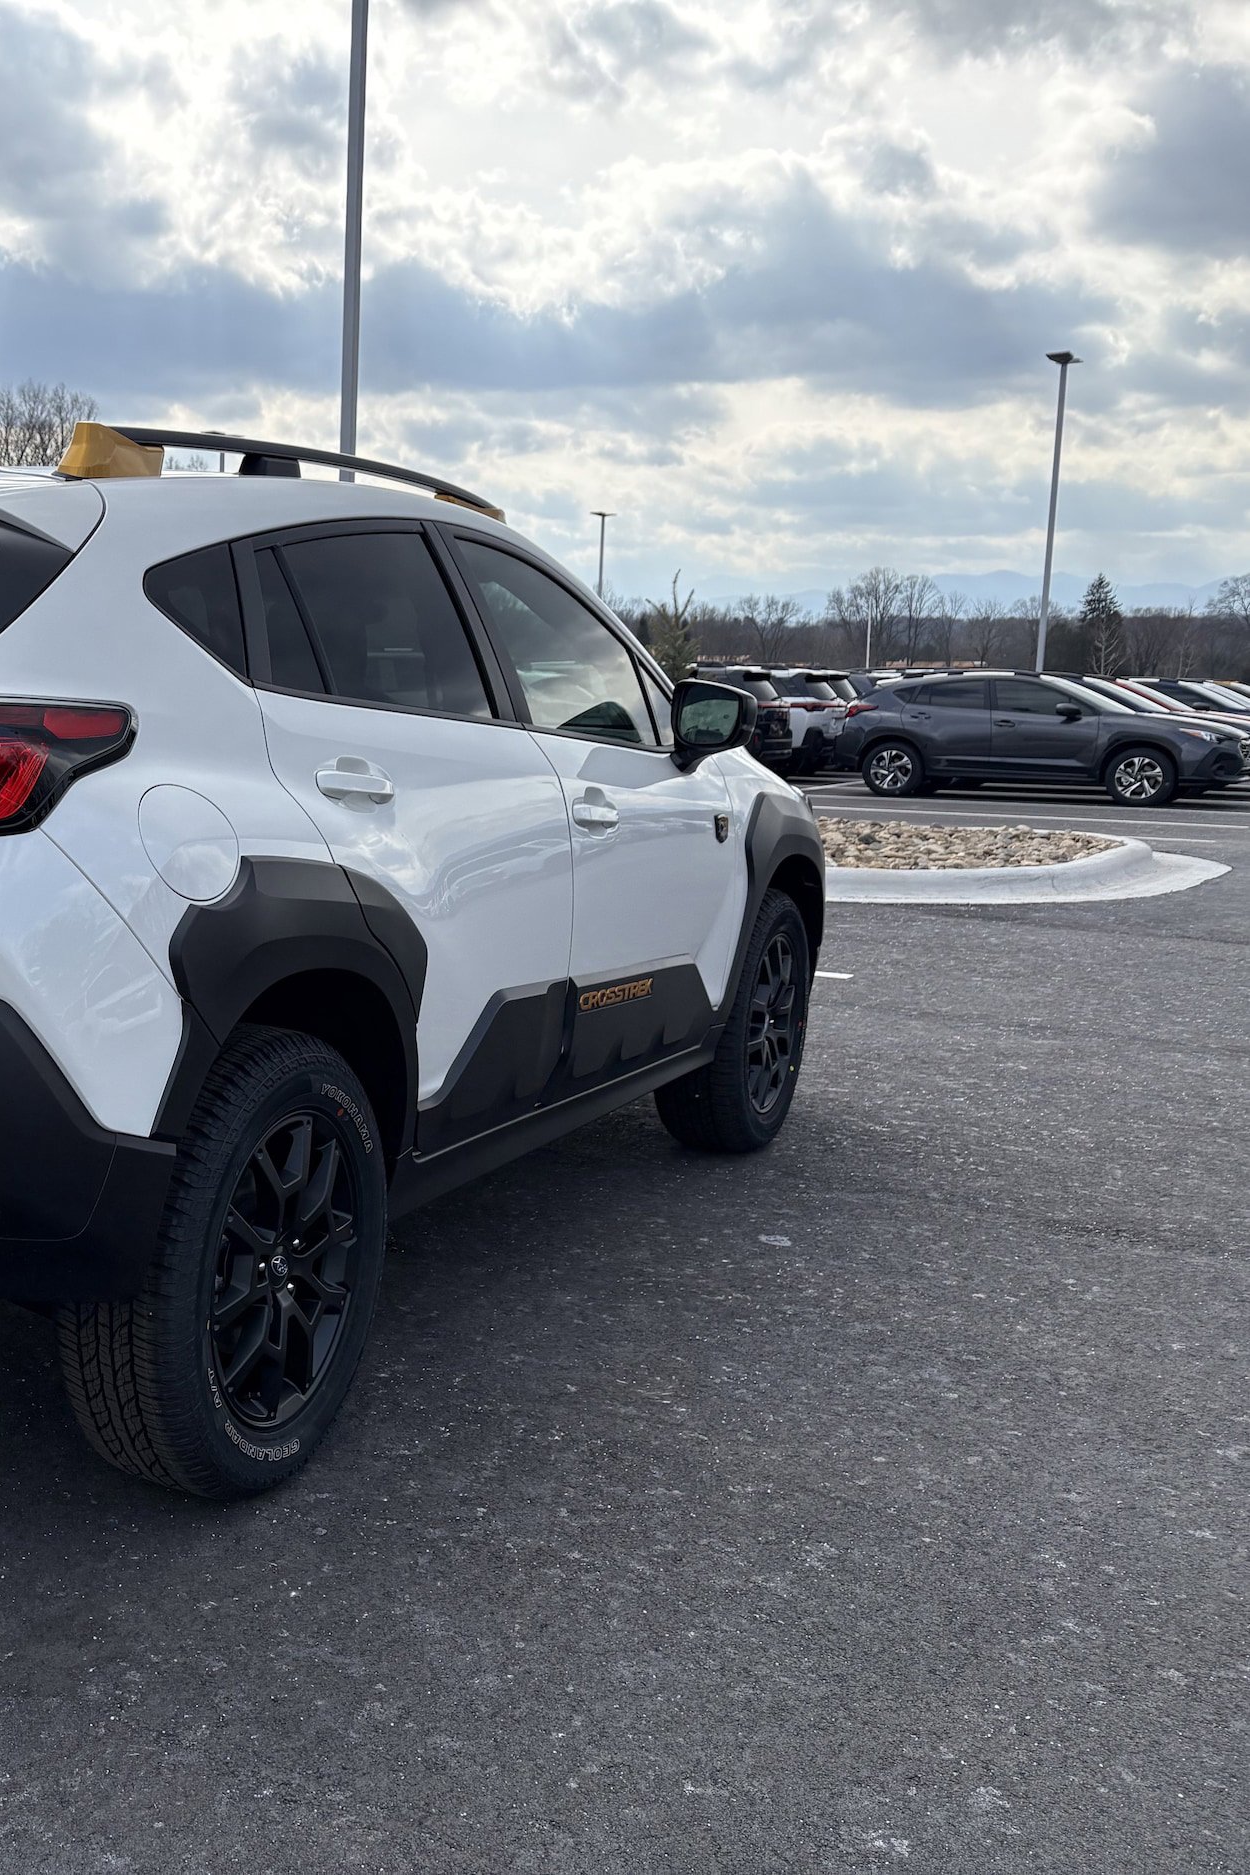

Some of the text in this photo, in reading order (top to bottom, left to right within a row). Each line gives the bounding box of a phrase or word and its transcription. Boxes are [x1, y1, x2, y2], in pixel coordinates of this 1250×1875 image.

[579, 978, 653, 1010] CROSSTREK
[321, 1083, 373, 1153] YOKOHAMA
[224, 1419, 300, 1461] GEOLANDAR
